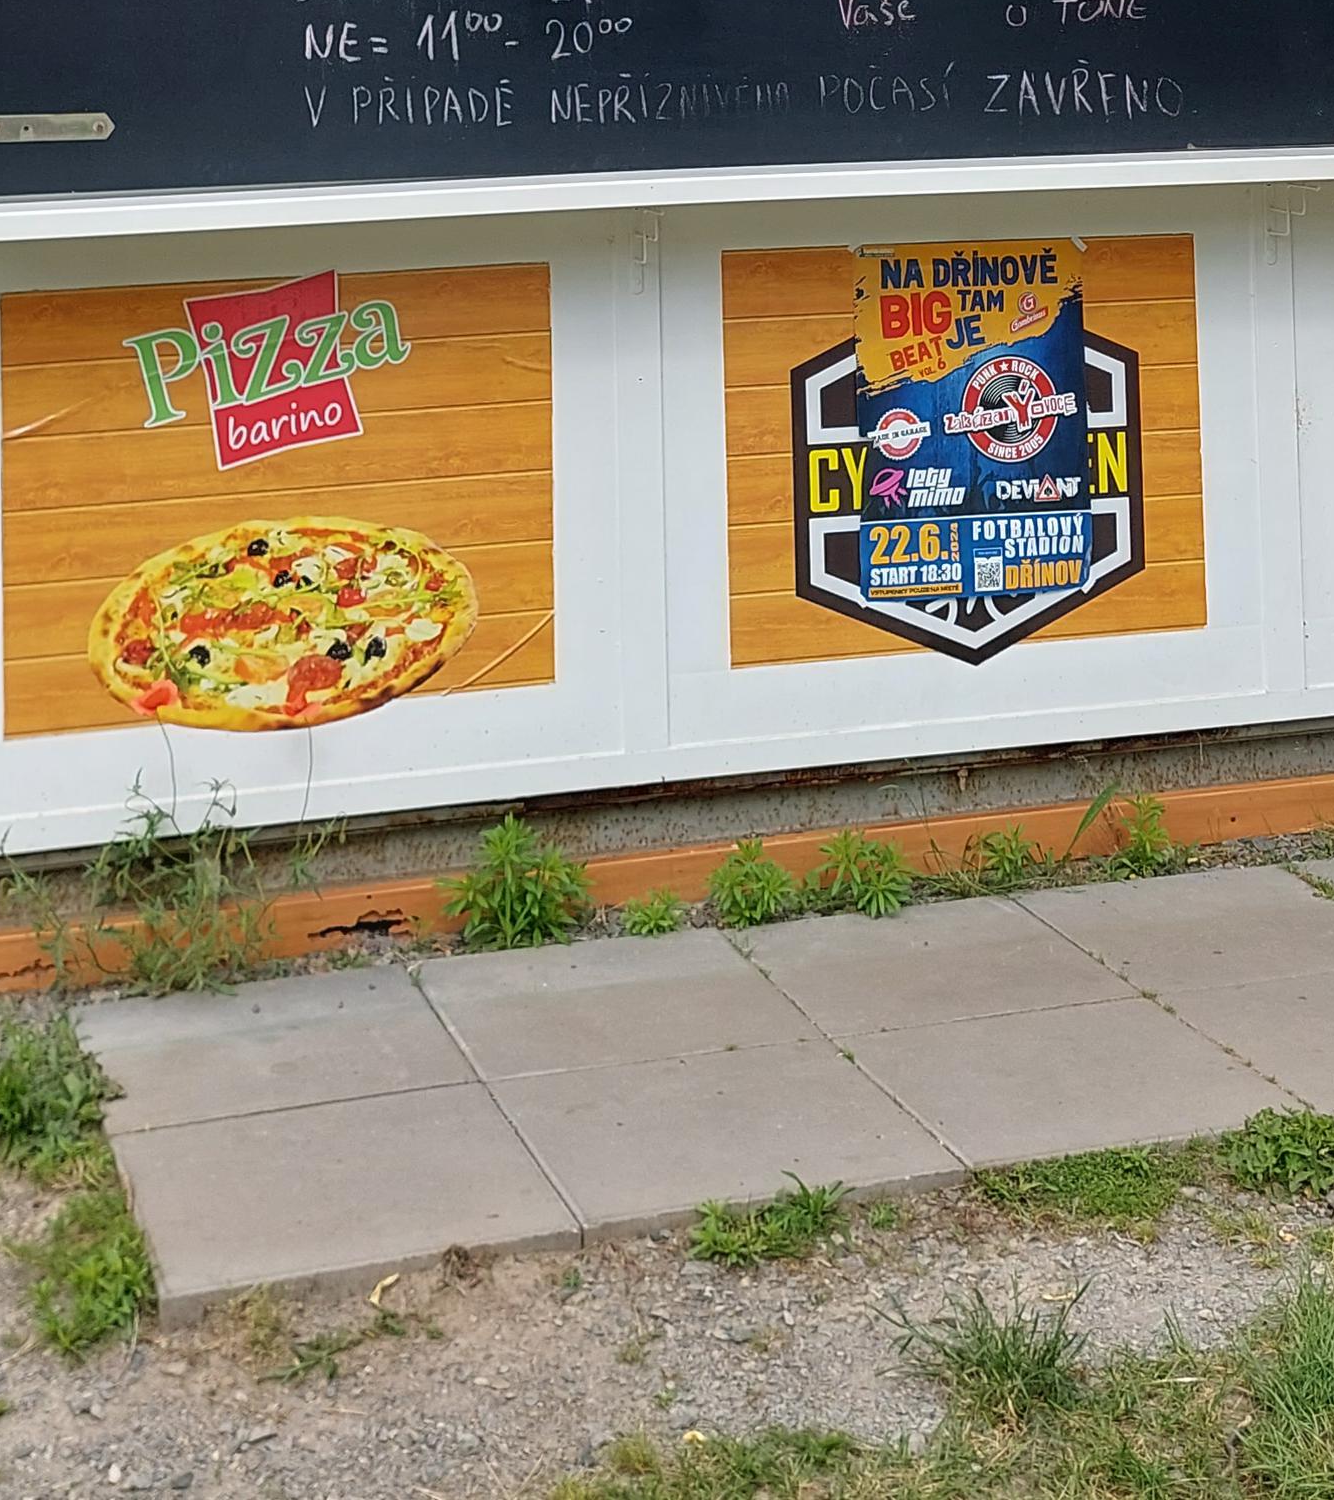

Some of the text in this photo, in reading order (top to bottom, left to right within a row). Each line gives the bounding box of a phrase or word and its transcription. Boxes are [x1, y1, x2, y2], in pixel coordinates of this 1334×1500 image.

[1004, 5, 1028, 27] U
[304, 23, 362, 62] NE
[304, 86, 327, 127] V
[880, 248, 1058, 289] NA DŘÍNOVĚ
[879, 289, 1004, 339] BIG TAM
[946, 314, 986, 349] JE
[123, 300, 411, 428] Pizza
[889, 335, 943, 371] BEAT
[938, 358, 946, 370] 6
[972, 361, 1039, 390] PUNK ROCK
[227, 402, 342, 450] barino
[987, 435, 1044, 459] SINCE 2005
[908, 486, 966, 508] mimo
[996, 473, 1081, 502] DEVIANT
[972, 513, 1084, 541] FOTBALOVÝ
[869, 523, 949, 565] 22.6.
[870, 562, 962, 586] START 18:30
[1005, 559, 1082, 590] DŘÍNOV
